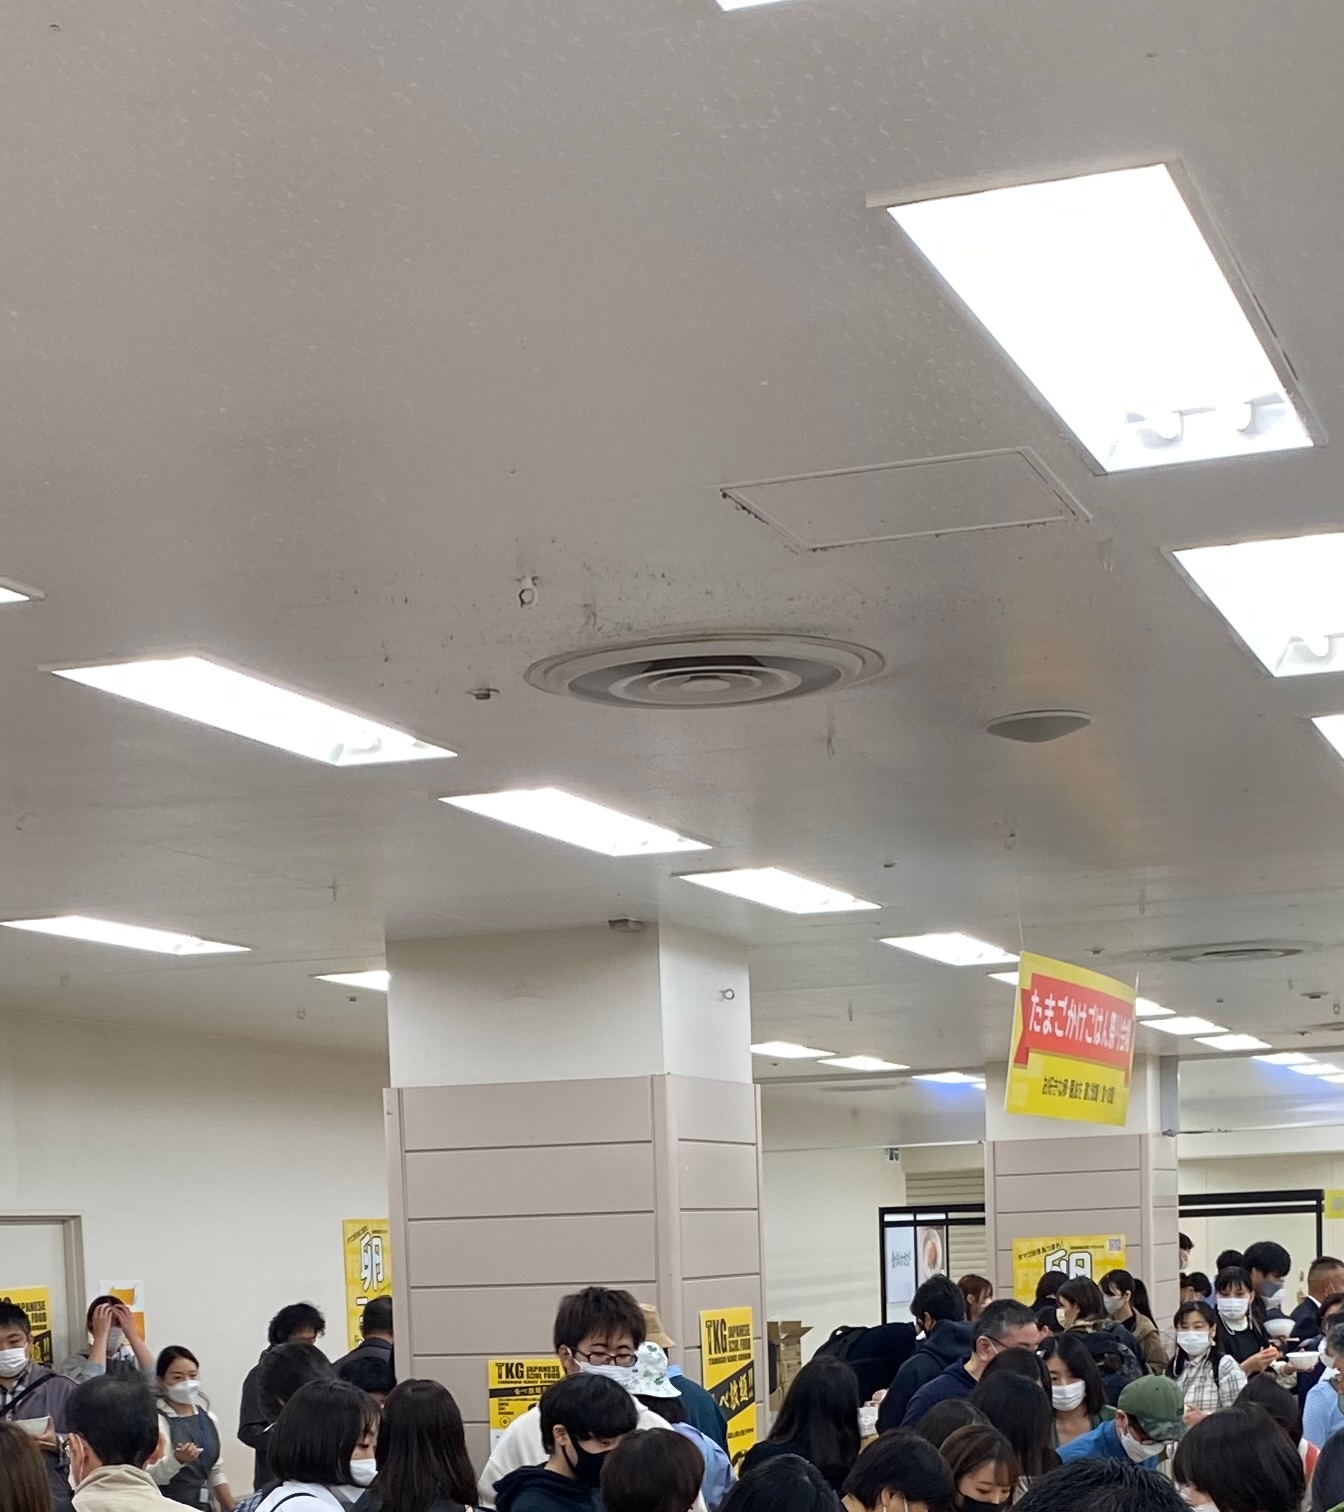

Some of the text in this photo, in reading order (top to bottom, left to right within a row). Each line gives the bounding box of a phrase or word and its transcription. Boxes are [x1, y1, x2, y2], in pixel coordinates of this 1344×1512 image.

[360, 1231, 385, 1293] 卵
[31, 1312, 47, 1323] FOOD
[705, 1318, 727, 1355] TKG
[495, 1362, 524, 1379] TKG
